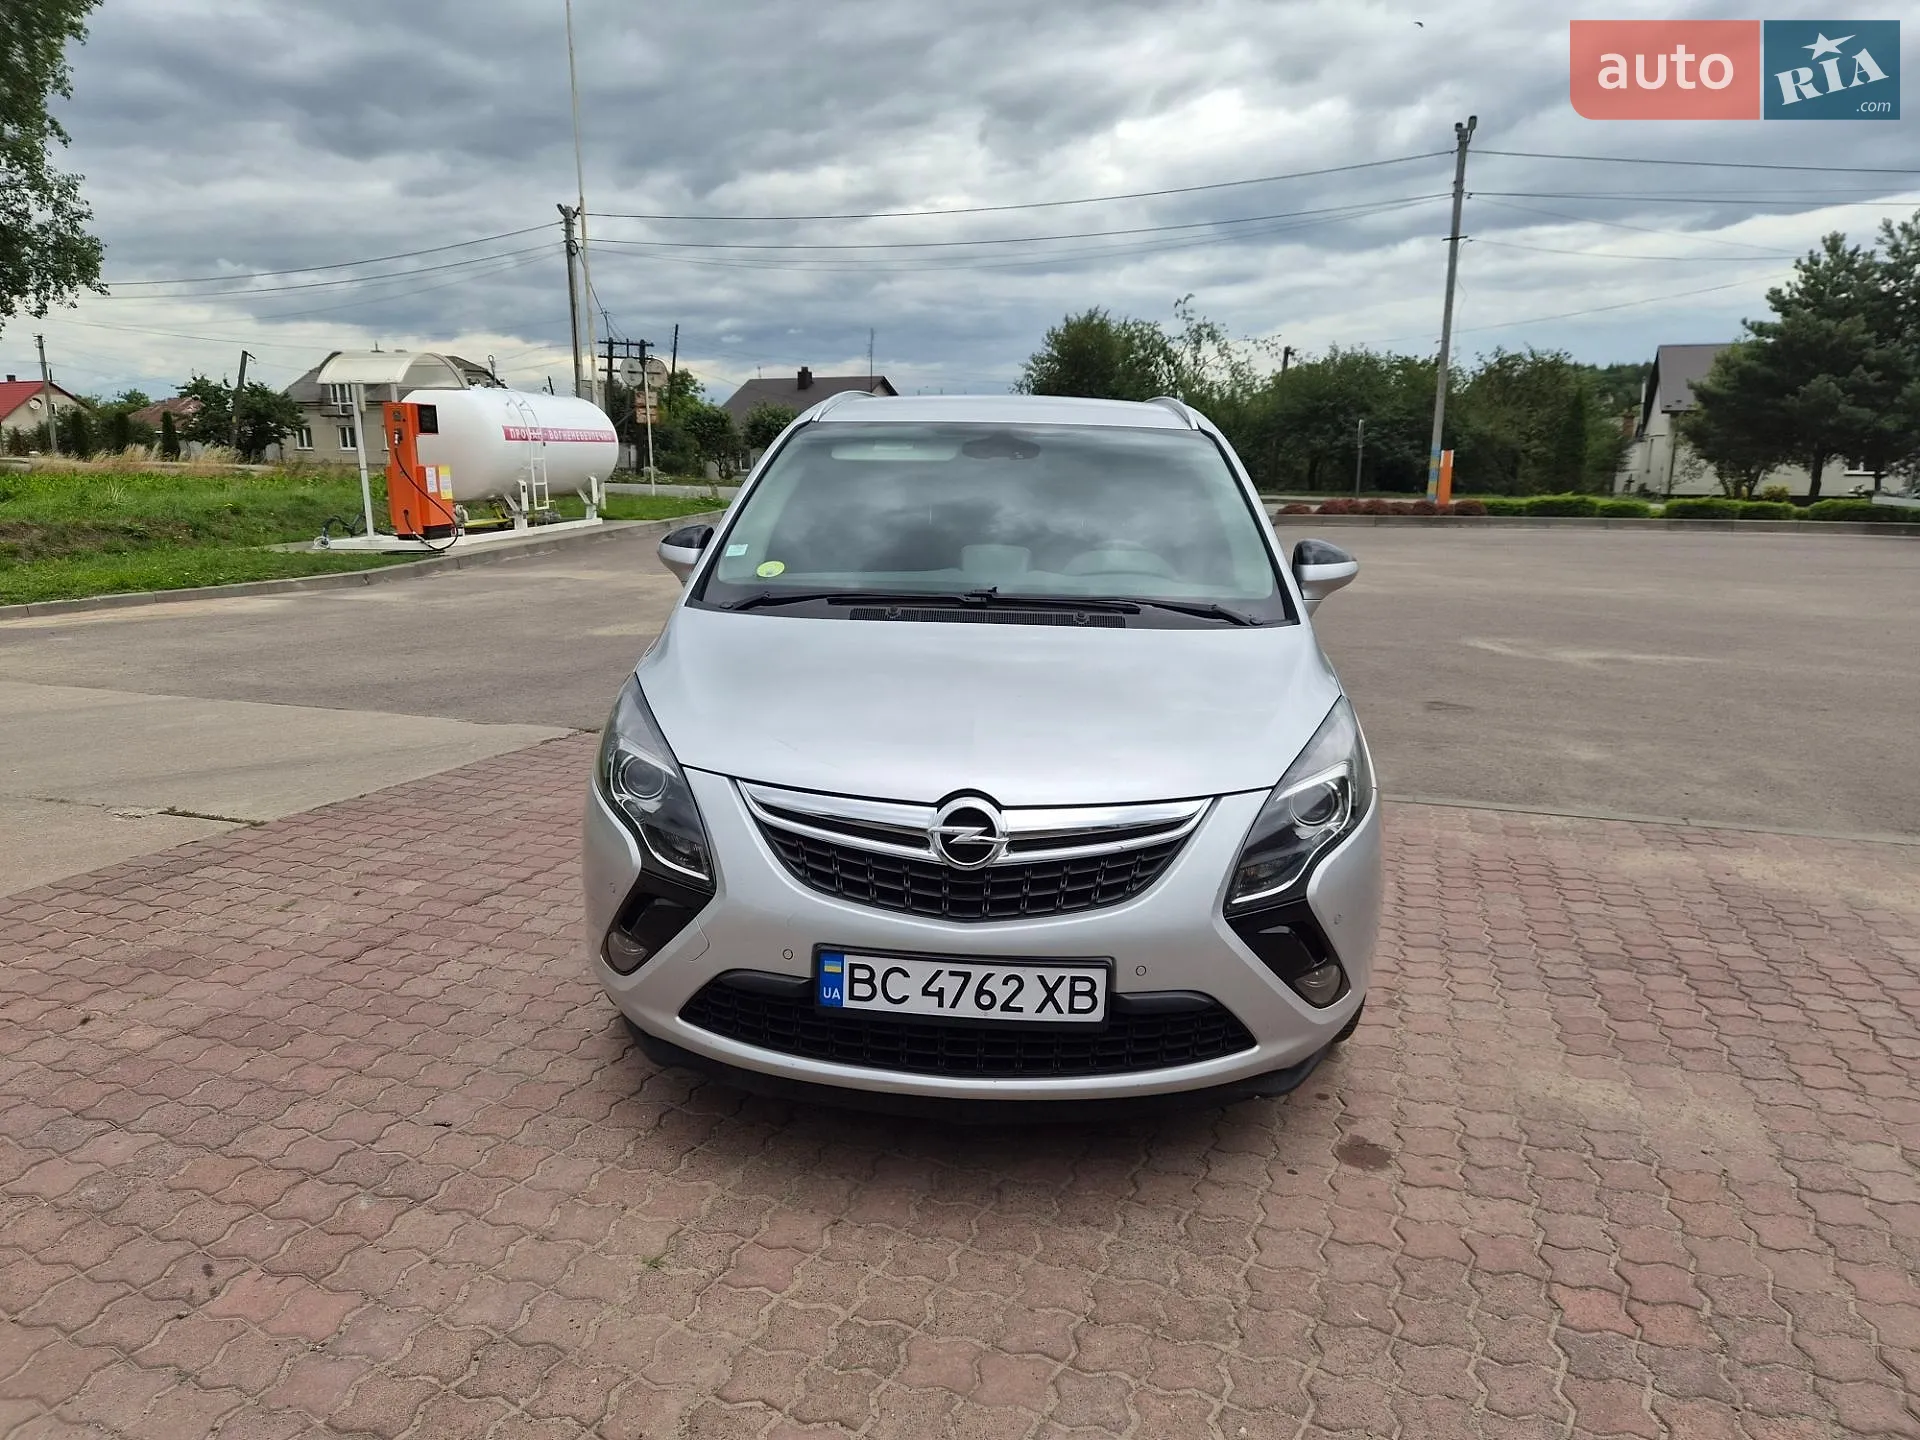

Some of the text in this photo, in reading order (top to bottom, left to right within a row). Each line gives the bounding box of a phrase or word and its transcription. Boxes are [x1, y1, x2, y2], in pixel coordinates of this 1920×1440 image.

[823, 986, 841, 1000] UA
[848, 962, 1099, 1015] BC 4762 XB
